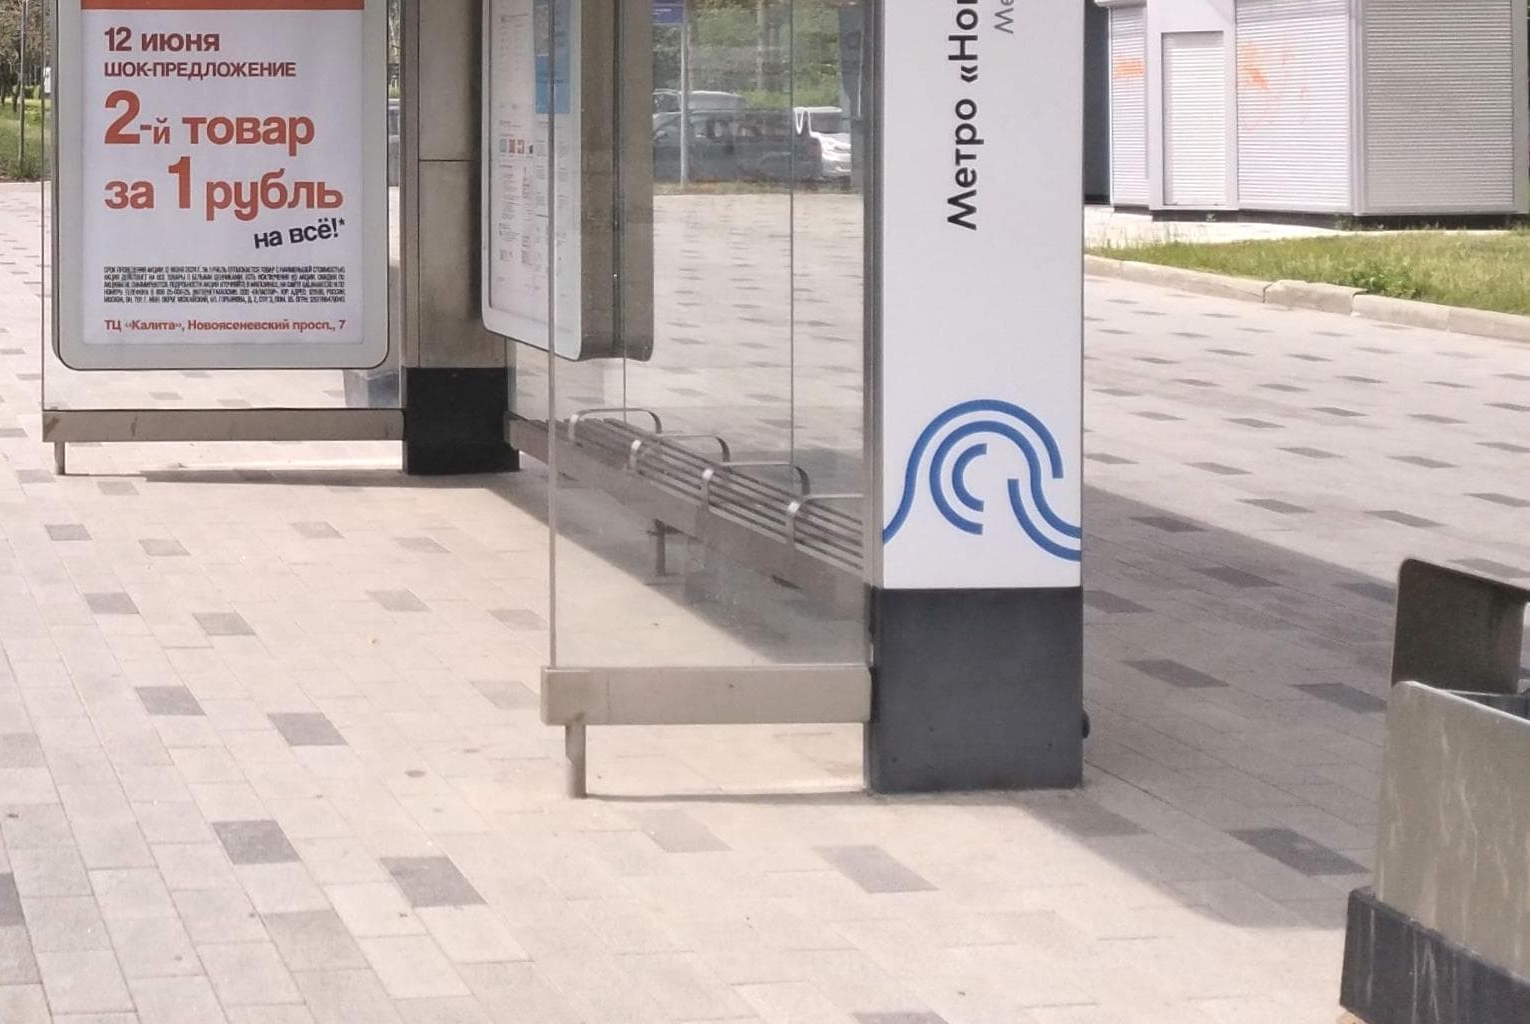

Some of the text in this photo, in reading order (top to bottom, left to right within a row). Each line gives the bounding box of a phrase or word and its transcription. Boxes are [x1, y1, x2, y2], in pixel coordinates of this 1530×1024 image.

[104, 27, 132, 51] 12
[104, 61, 297, 80] ШОК-ПРЕДЛОЖЕНИЕ
[104, 89, 315, 157] 2-й товар
[946, 98, 985, 231] Метро
[104, 156, 344, 222] за 1 рубль
[254, 231, 283, 249] на
[104, 320, 122, 332] ТЦ
[188, 318, 290, 331] Новоясеневский
[338, 320, 346, 331] 7
